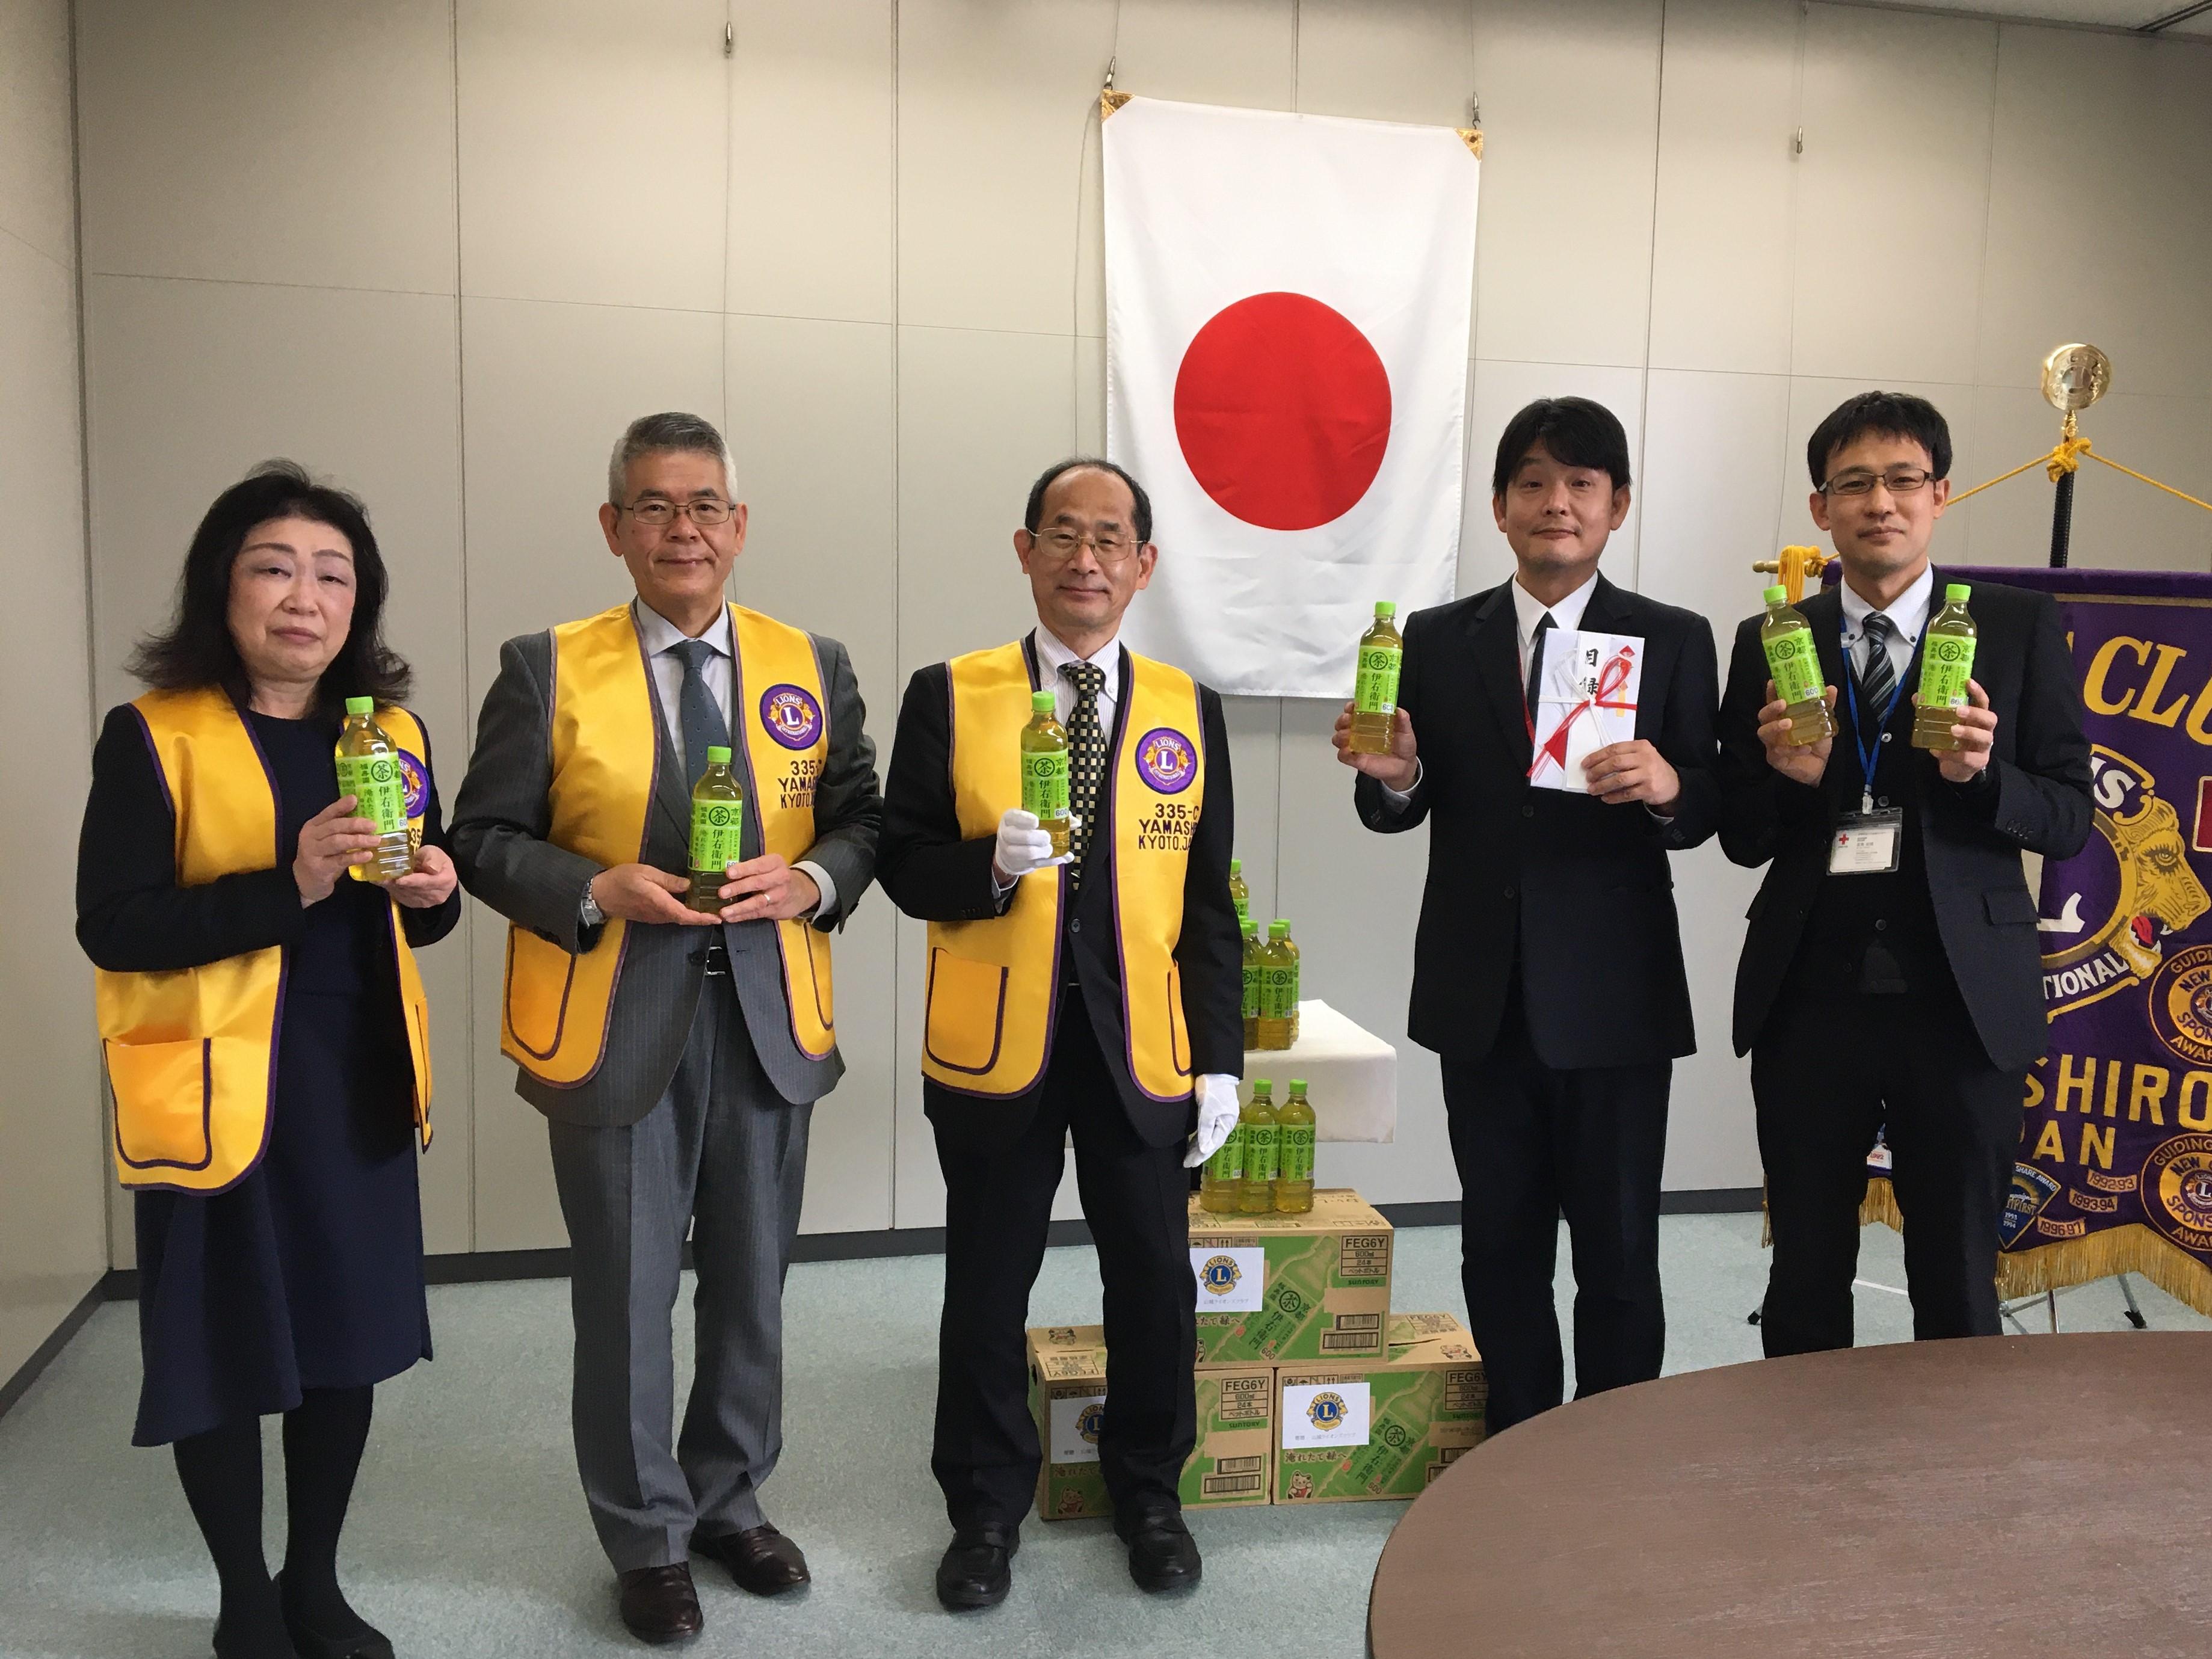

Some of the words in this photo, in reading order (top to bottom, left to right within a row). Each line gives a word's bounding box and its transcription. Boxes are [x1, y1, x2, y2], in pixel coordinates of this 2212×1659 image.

[1779, 642, 1793, 657] 茶
[1943, 644, 1957, 659] 茶
[1372, 654, 1385, 668] 茶
[1784, 661, 1803, 701] 伊右衛門
[1936, 663, 1953, 706] 伊右衛門
[1369, 673, 1382, 710] 伊右衛門
[776, 695, 801, 706] LIONS
[784, 707, 799, 725] L
[1156, 739, 1179, 750] LIONS
[1038, 761, 1052, 775] 茶
[1160, 751, 1174, 770] L
[375, 763, 390, 780] 茶
[1040, 780, 1051, 818] 伊右衛門
[379, 786, 395, 831] 伊右衛門
[1155, 803, 1200, 820] 335-C
[713, 810, 727, 823] 茶
[712, 830, 724, 870] 伊右衛門
[1275, 973, 1285, 983] 茶
[2178, 968, 2211, 993] NEW
[1260, 1131, 1270, 1143] 茶
[1296, 1131, 1306, 1143] 茶
[2019, 1119, 2116, 1170] AN
[2170, 1156, 2201, 1177] NEW
[2015, 1165, 2037, 1179] SHARE
[2035, 1174, 2057, 1192] AWARD
[2199, 1181, 2211, 1198] L
[1346, 1238, 1385, 1248] FEG6Y
[1209, 1257, 1233, 1266] LIONS
[1216, 1268, 1227, 1282] L
[1282, 1293, 1298, 1310] 茶
[1248, 1311, 1284, 1350] 伊右衛門
[1261, 1347, 1275, 1360] 600
[1225, 1379, 1266, 1391] FEG6Y
[1316, 1394, 1339, 1403] LIONS
[1085, 1405, 1104, 1415] LION
[1323, 1404, 1334, 1418] L
[1387, 1427, 1403, 1444] 茶
[1368, 1482, 1382, 1495] 600
